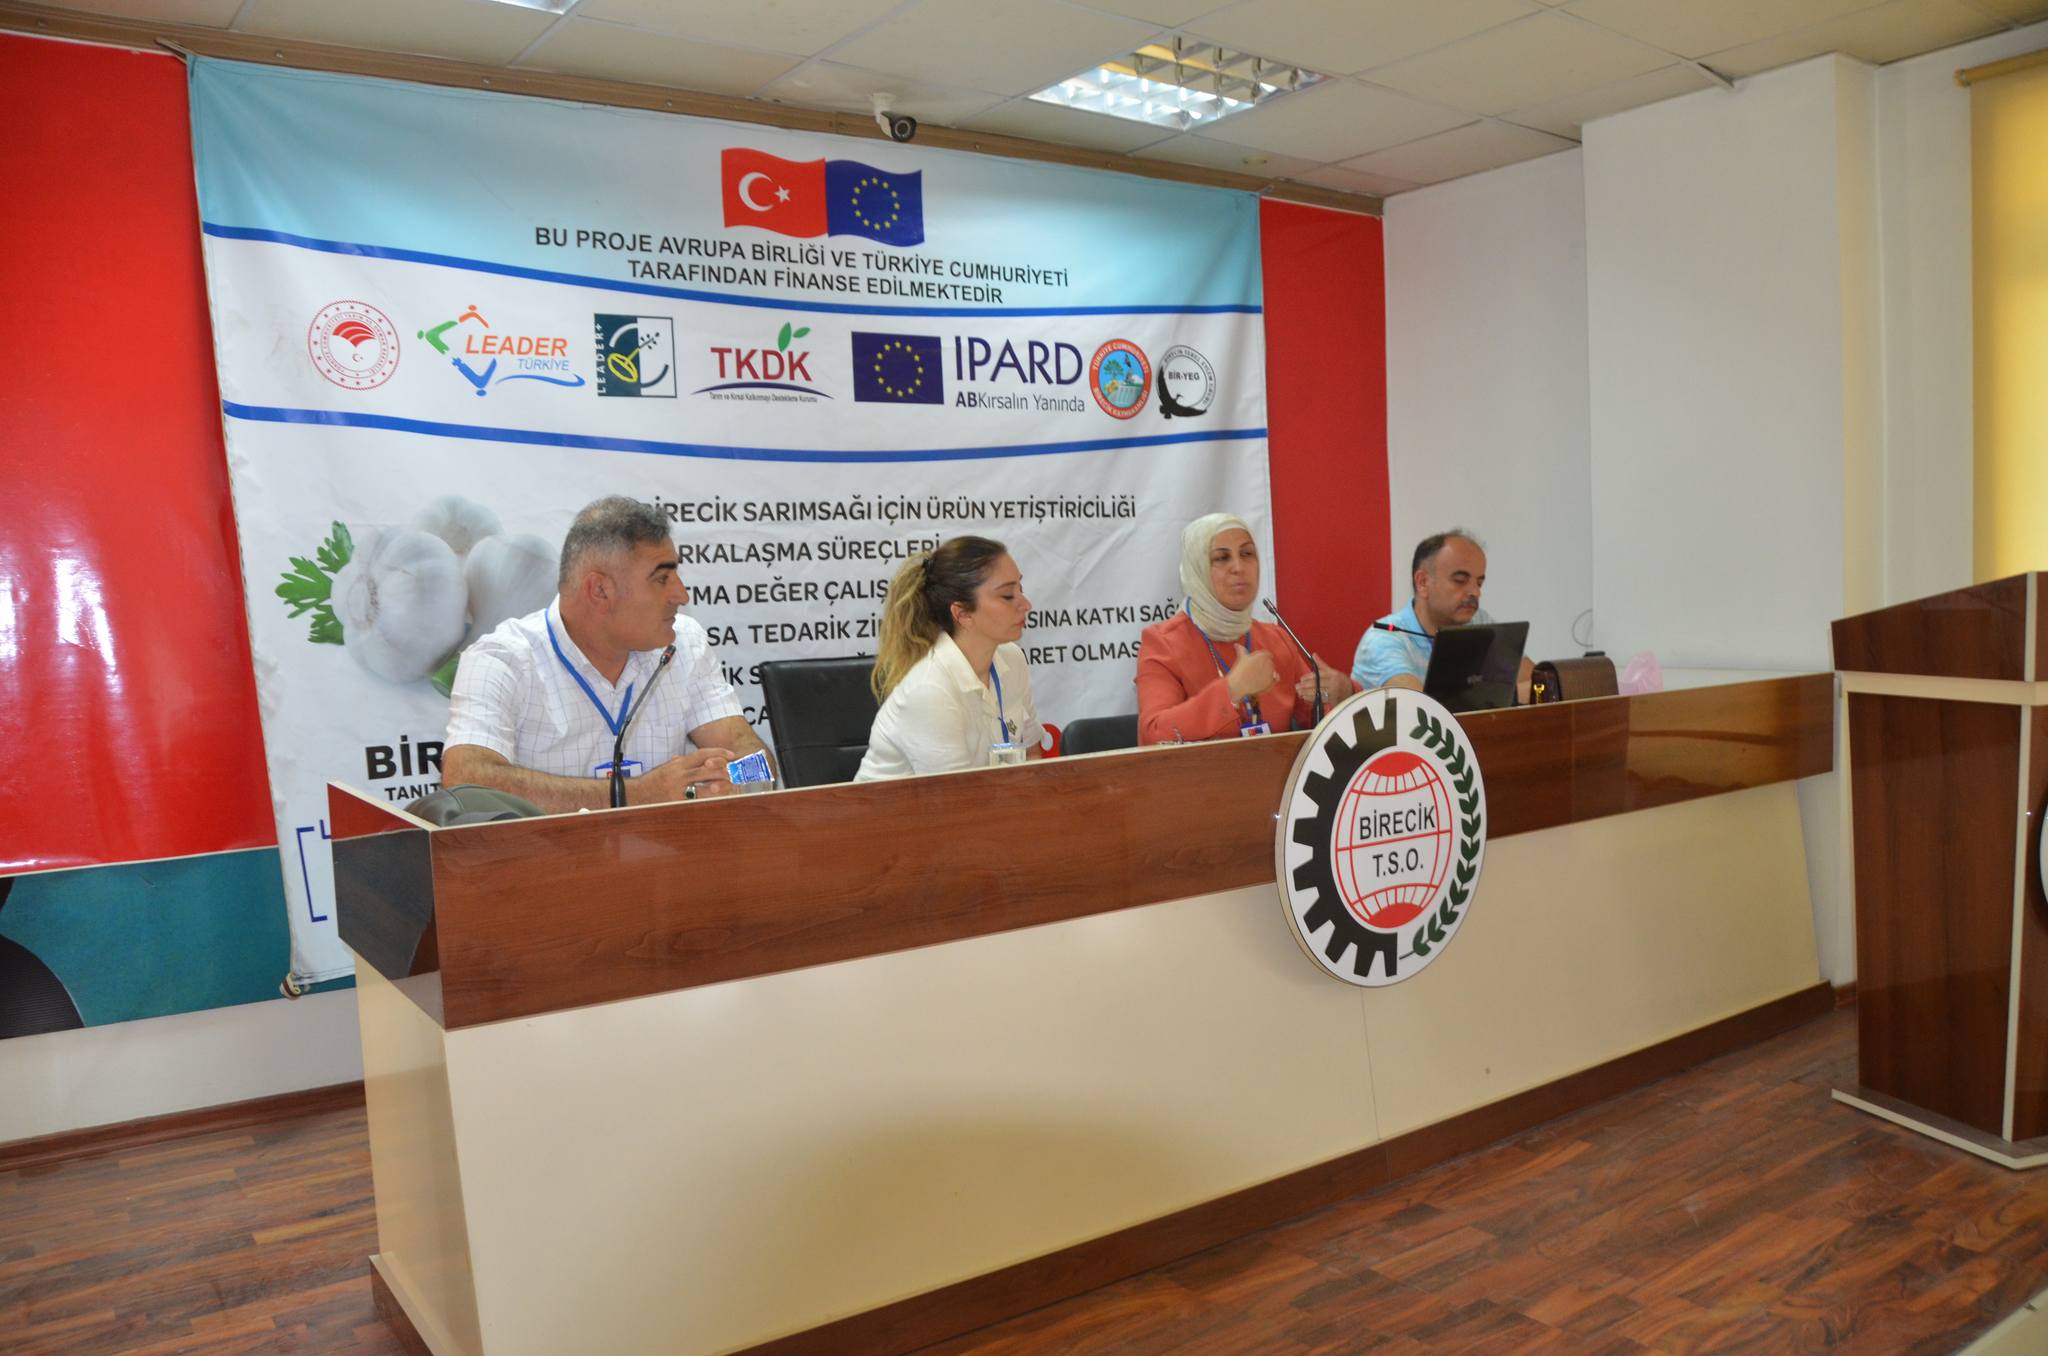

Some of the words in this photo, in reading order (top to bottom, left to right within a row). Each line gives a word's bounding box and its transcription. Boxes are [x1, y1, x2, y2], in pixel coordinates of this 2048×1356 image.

[536, 227, 567, 247] BU
[576, 230, 652, 253] PROJE
[659, 236, 746, 260] AVRUPA
[752, 240, 825, 266] BİRLİĞİ
[831, 250, 857, 269] VE
[862, 250, 944, 276] TÜRKİYE
[950, 260, 1069, 287] CUMHURİYETİ
[628, 260, 766, 286] TARAFINDAN
[774, 267, 861, 293] FİNANSE
[867, 275, 1003, 303] EDİLMEKTEDİR
[465, 334, 568, 357] LEADER
[955, 335, 1083, 385] IPARD
[517, 356, 569, 372] TÜRKİYE
[710, 347, 812, 382] TKDK
[1033, 390, 1085, 412] Yanında
[644, 496, 738, 522] İRECİK
[743, 494, 872, 522] SARIMSAĞI
[877, 495, 921, 526] İÇİN
[927, 495, 985, 520] ÜRÜN
[990, 494, 1136, 525] YETİŞTİRİCİLİĞİ
[736, 576, 818, 605] DEĞER
[748, 614, 850, 644] TEDARİK
[856, 612, 882, 638] Zİ
[1024, 610, 1072, 629] SINA
[1077, 606, 1135, 626] KATKI
[1140, 597, 1180, 622] SAĞ
[1359, 802, 1436, 840] BİRECİK
[1373, 848, 1424, 878] T.S.O.
